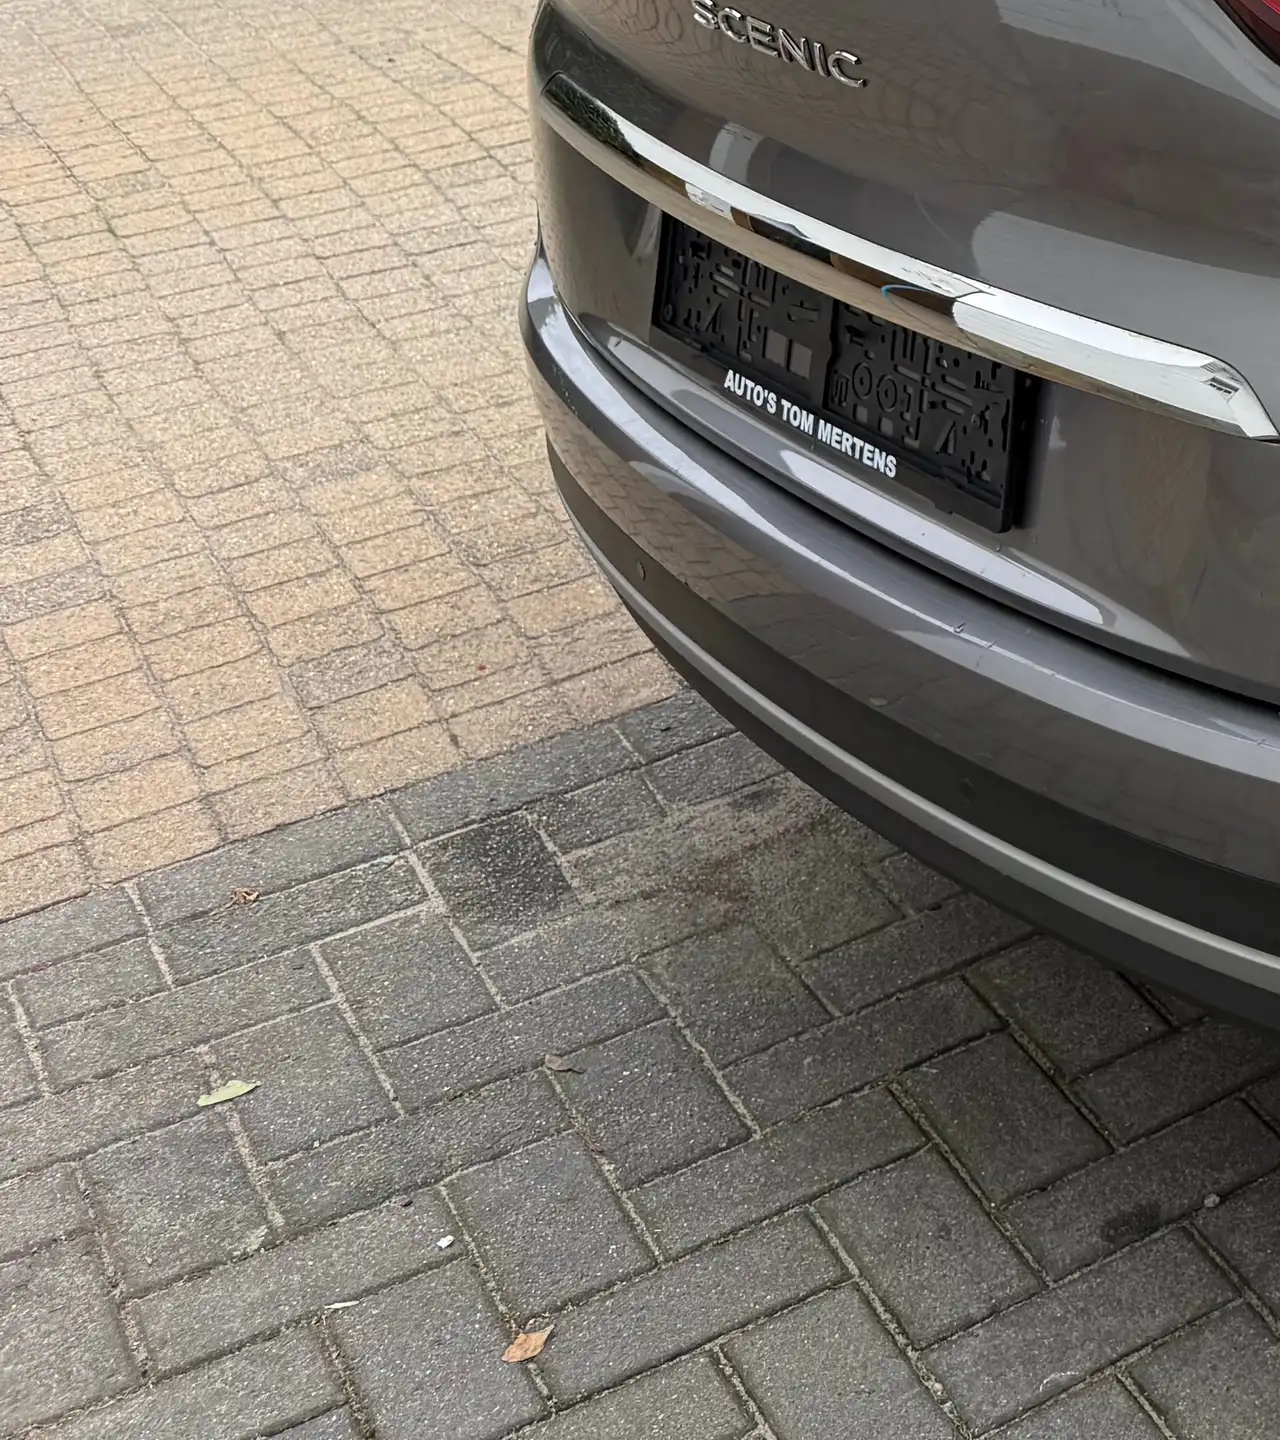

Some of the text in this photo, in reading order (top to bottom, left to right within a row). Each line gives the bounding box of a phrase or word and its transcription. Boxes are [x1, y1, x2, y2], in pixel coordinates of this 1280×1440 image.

[724, 369, 897, 478] AUTO'S TOM MERTENS
